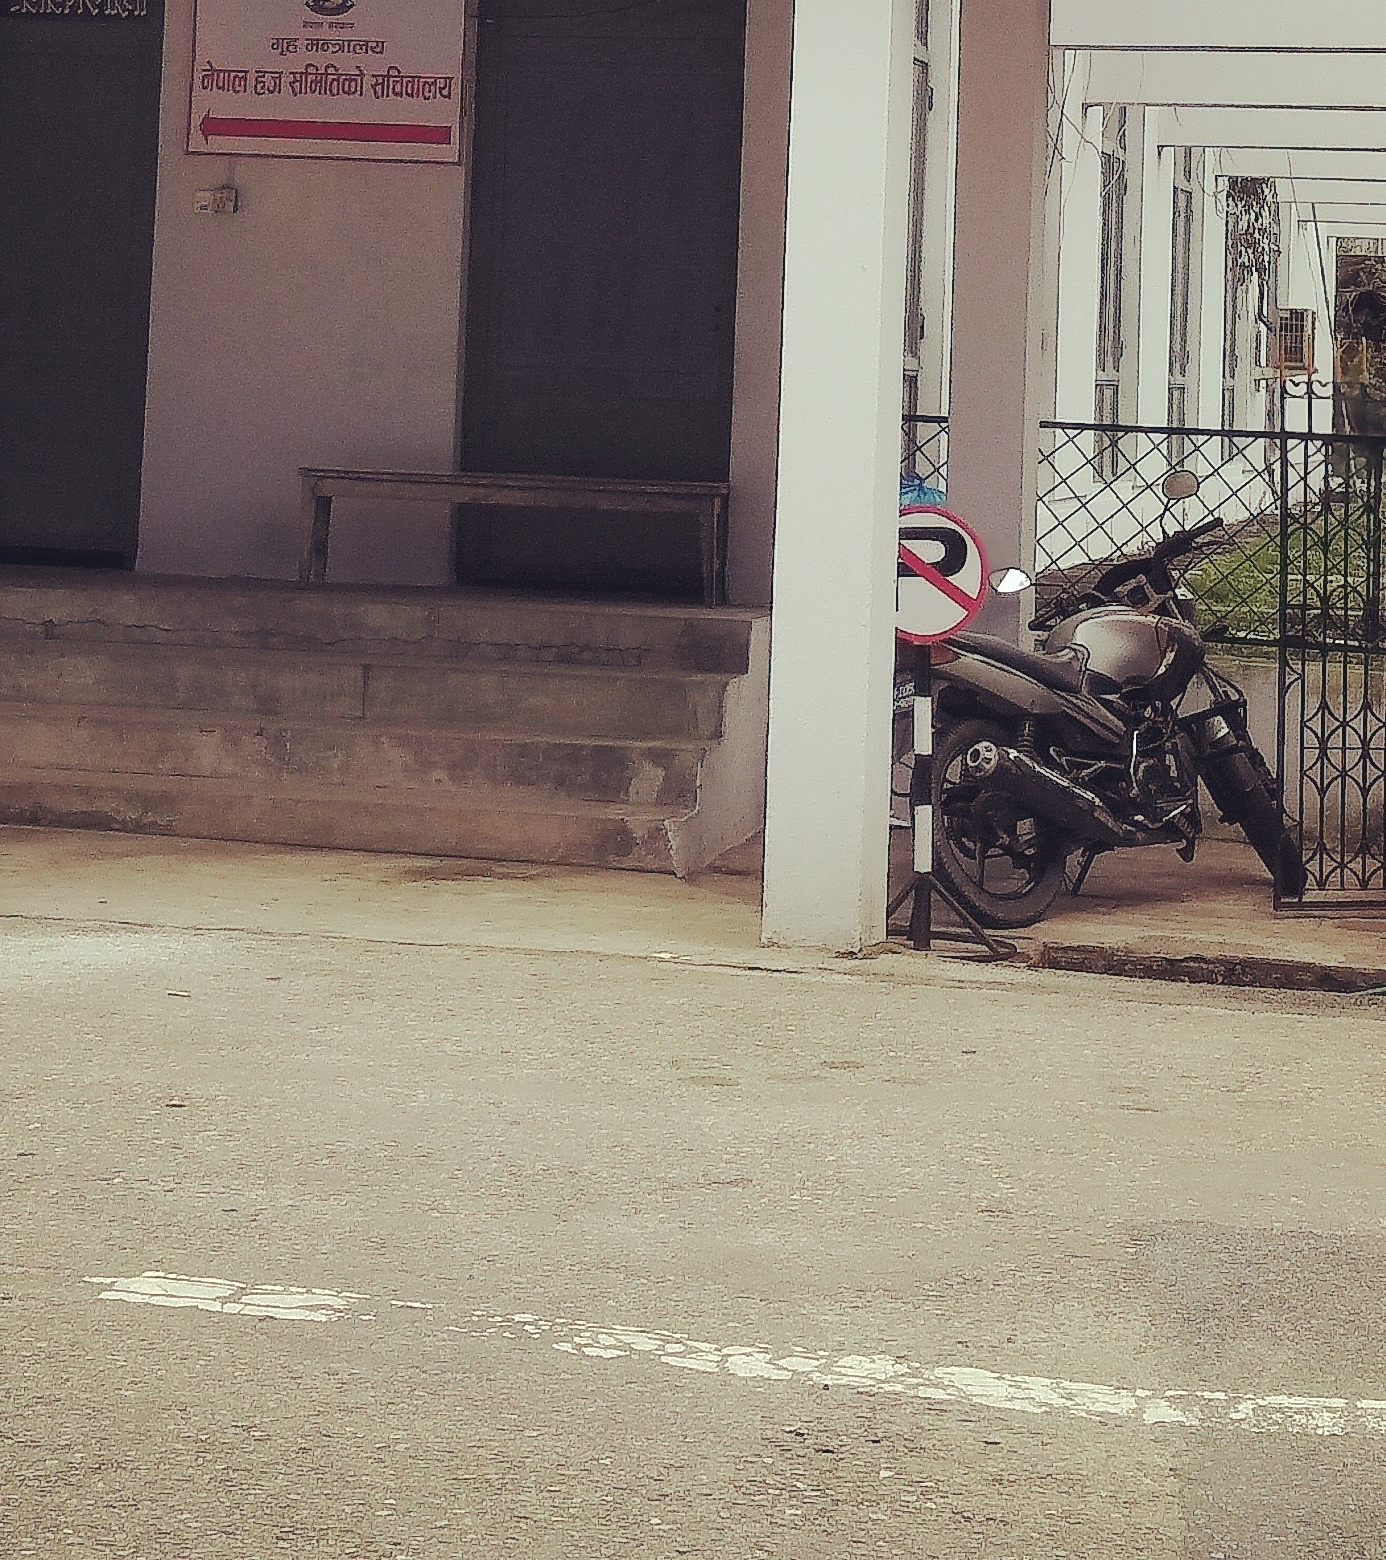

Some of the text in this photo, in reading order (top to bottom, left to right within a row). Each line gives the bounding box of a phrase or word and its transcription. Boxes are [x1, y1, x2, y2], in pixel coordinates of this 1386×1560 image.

[271, 37, 387, 56] गृह मन्त्रालय
[201, 60, 455, 101] नेपाल हज समितिको सचिवालय
